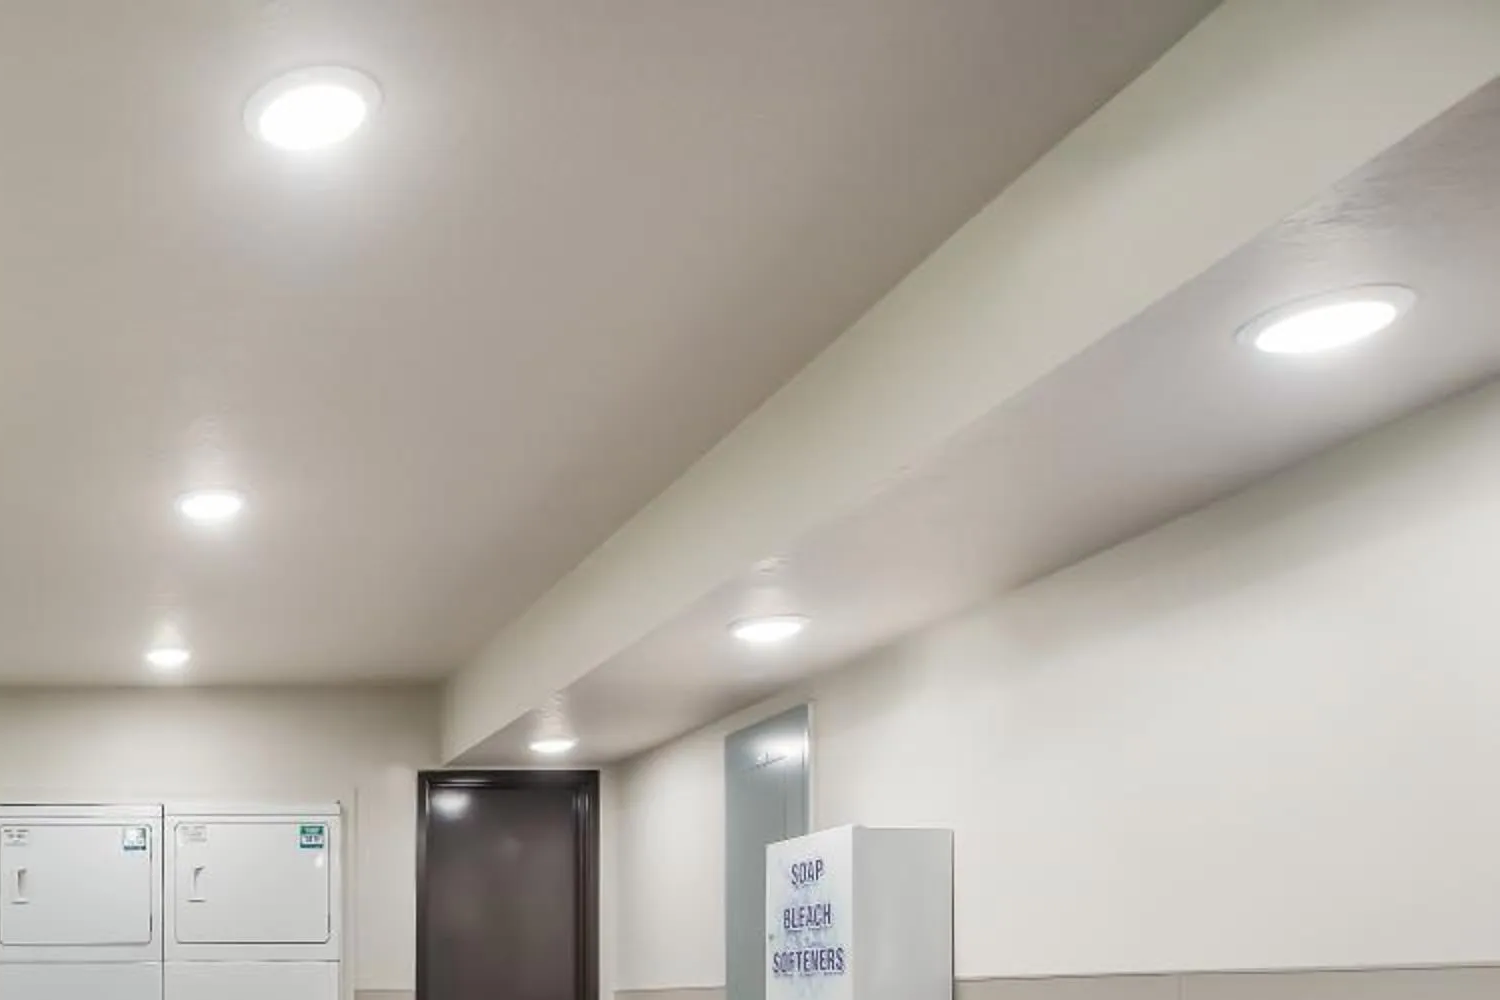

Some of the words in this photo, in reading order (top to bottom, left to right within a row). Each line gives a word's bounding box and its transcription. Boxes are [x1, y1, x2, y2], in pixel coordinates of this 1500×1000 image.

[791, 858, 824, 886] SOAP
[783, 902, 831, 929] BLEACH
[773, 946, 845, 973] SOFTENERS
